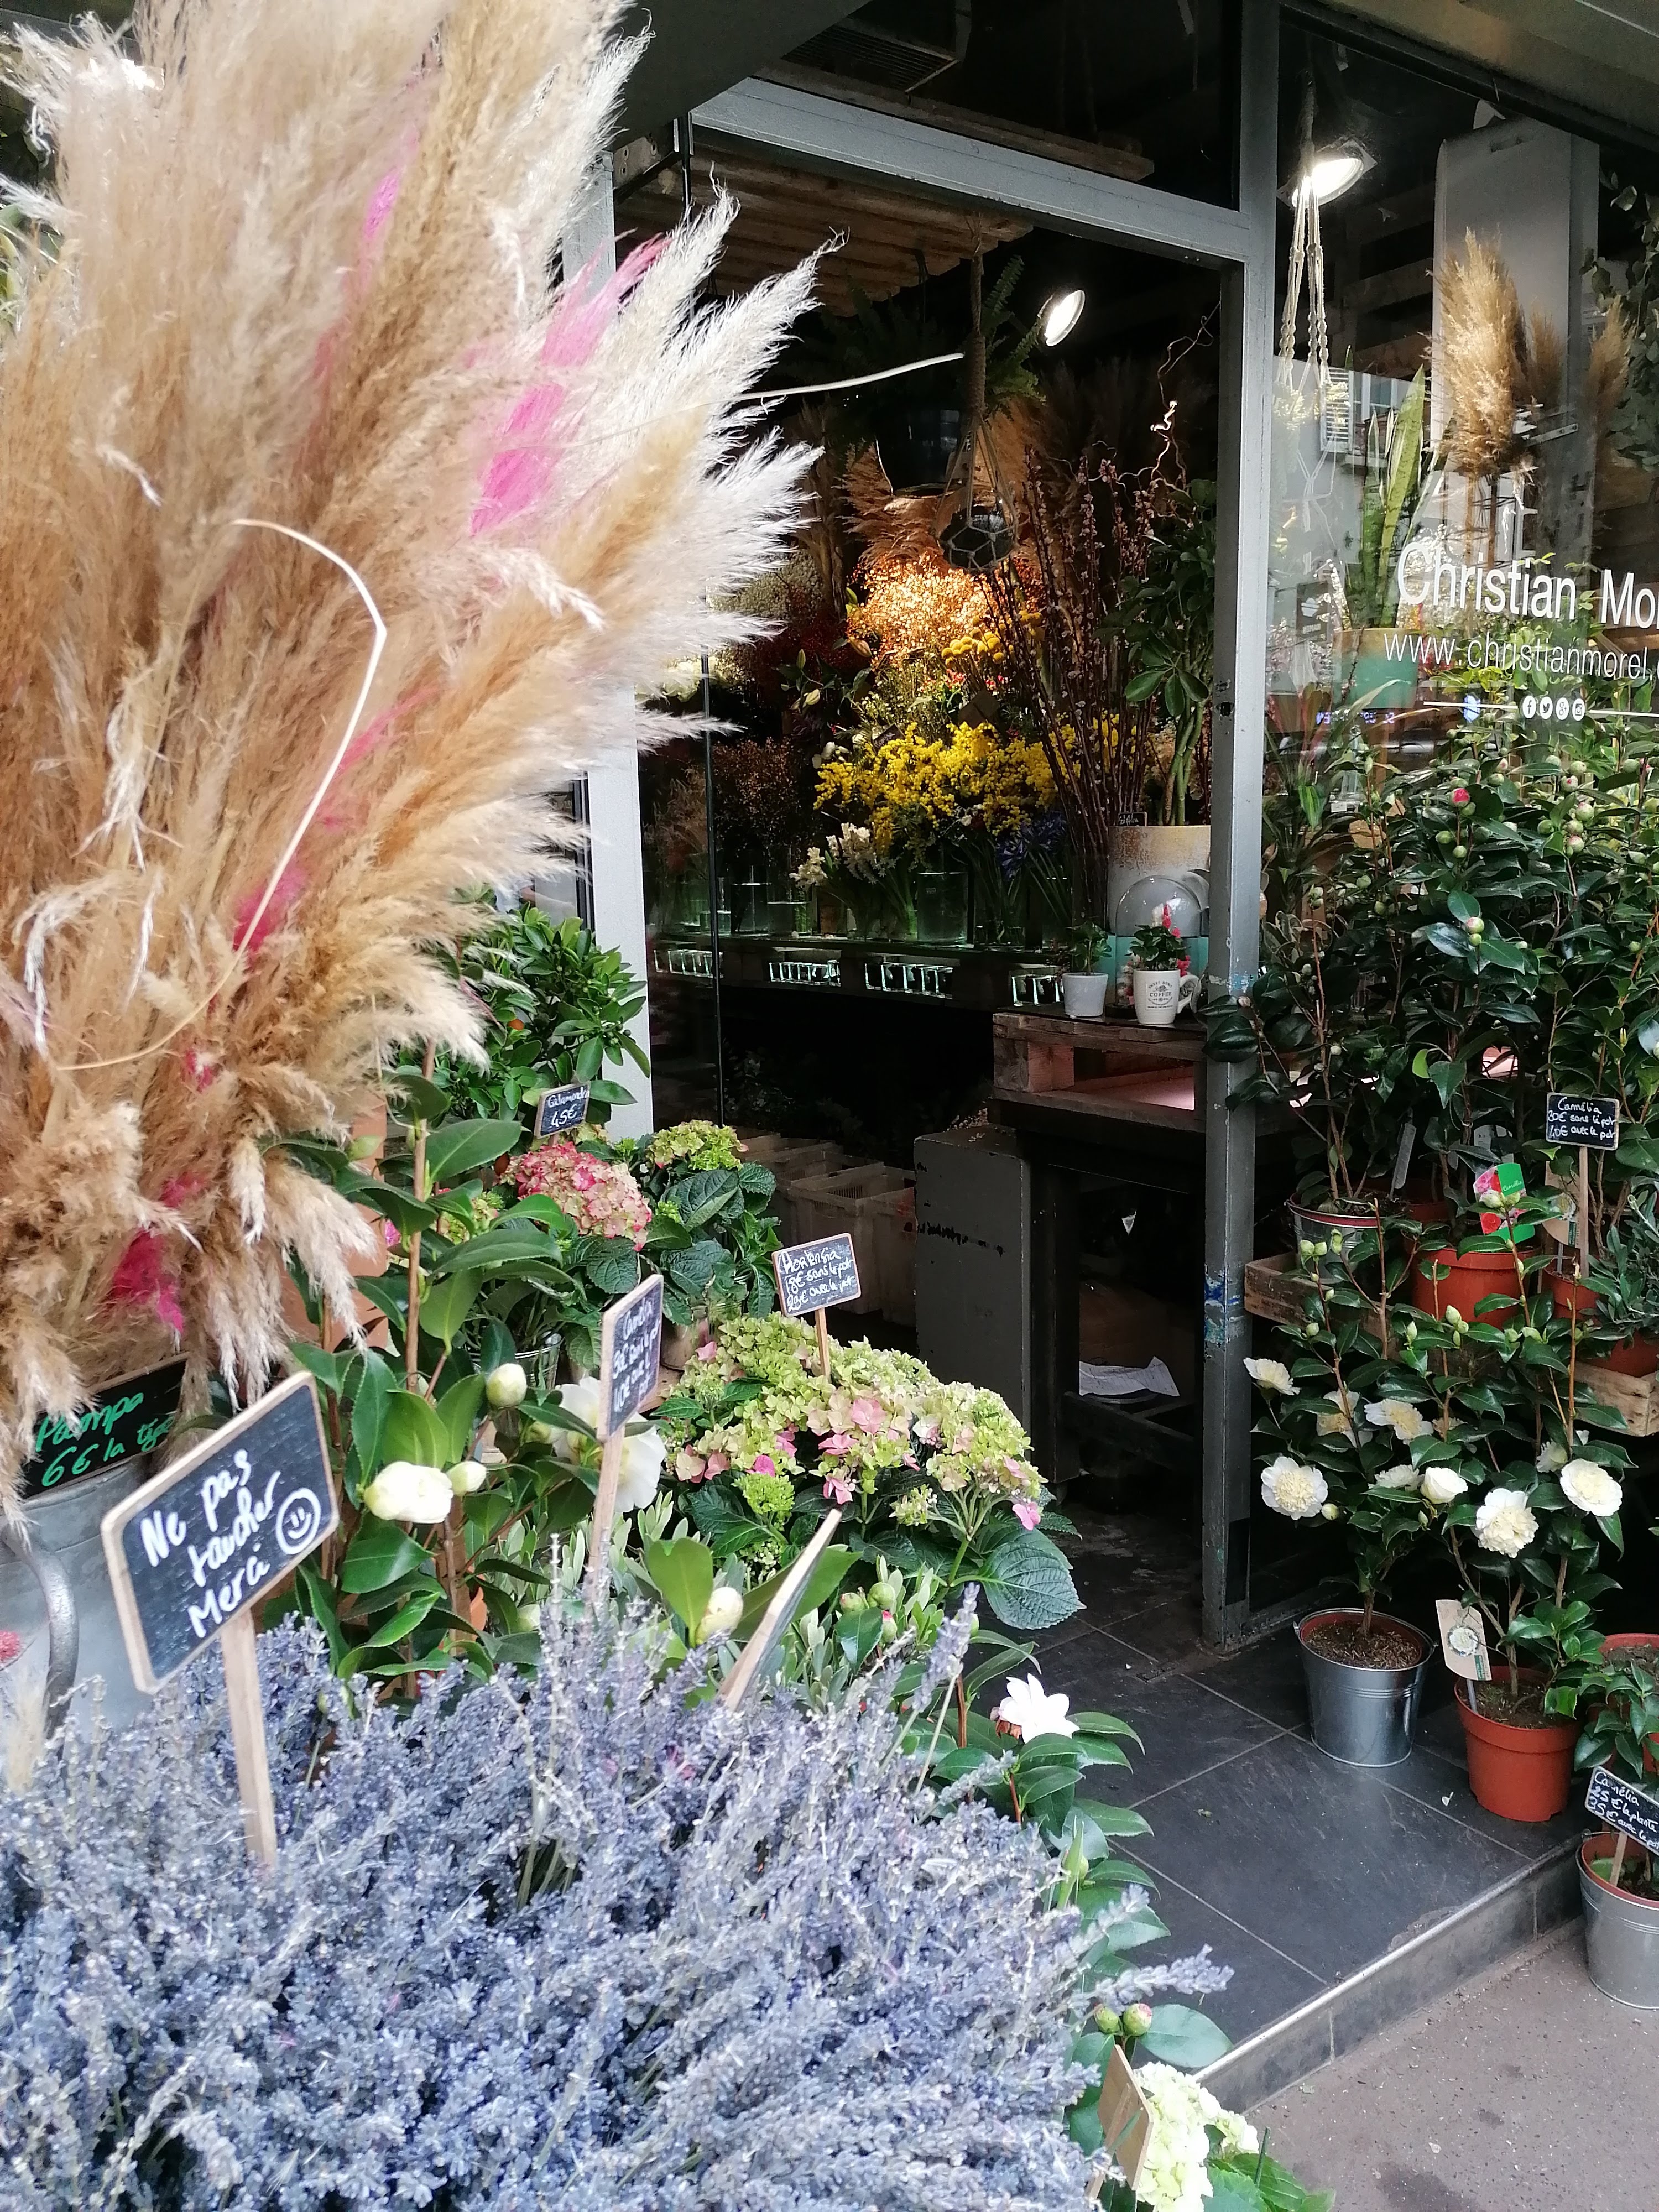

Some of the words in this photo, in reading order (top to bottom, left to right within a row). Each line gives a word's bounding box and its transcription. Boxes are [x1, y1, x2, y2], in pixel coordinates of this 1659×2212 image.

[1397, 542, 1576, 620] Christian
[1601, 569, 1659, 629] Mo
[1384, 632, 1659, 680] www.christianmorel.
[1548, 1110, 1567, 1122] 30€
[1558, 1097, 1602, 1114] Camélia
[1549, 1125, 1568, 1138] 40€
[1571, 1126, 1589, 1135] avec
[1590, 1126, 1598, 1136] le
[1600, 1129, 1617, 1141] pot
[806, 1265, 829, 1281] sans
[103, 1438, 126, 1462] la
[140, 1510, 186, 1567] Ne
[201, 1449, 251, 1532] pas
[187, 1470, 281, 1588] toucher
[187, 1542, 271, 1638] Merci
